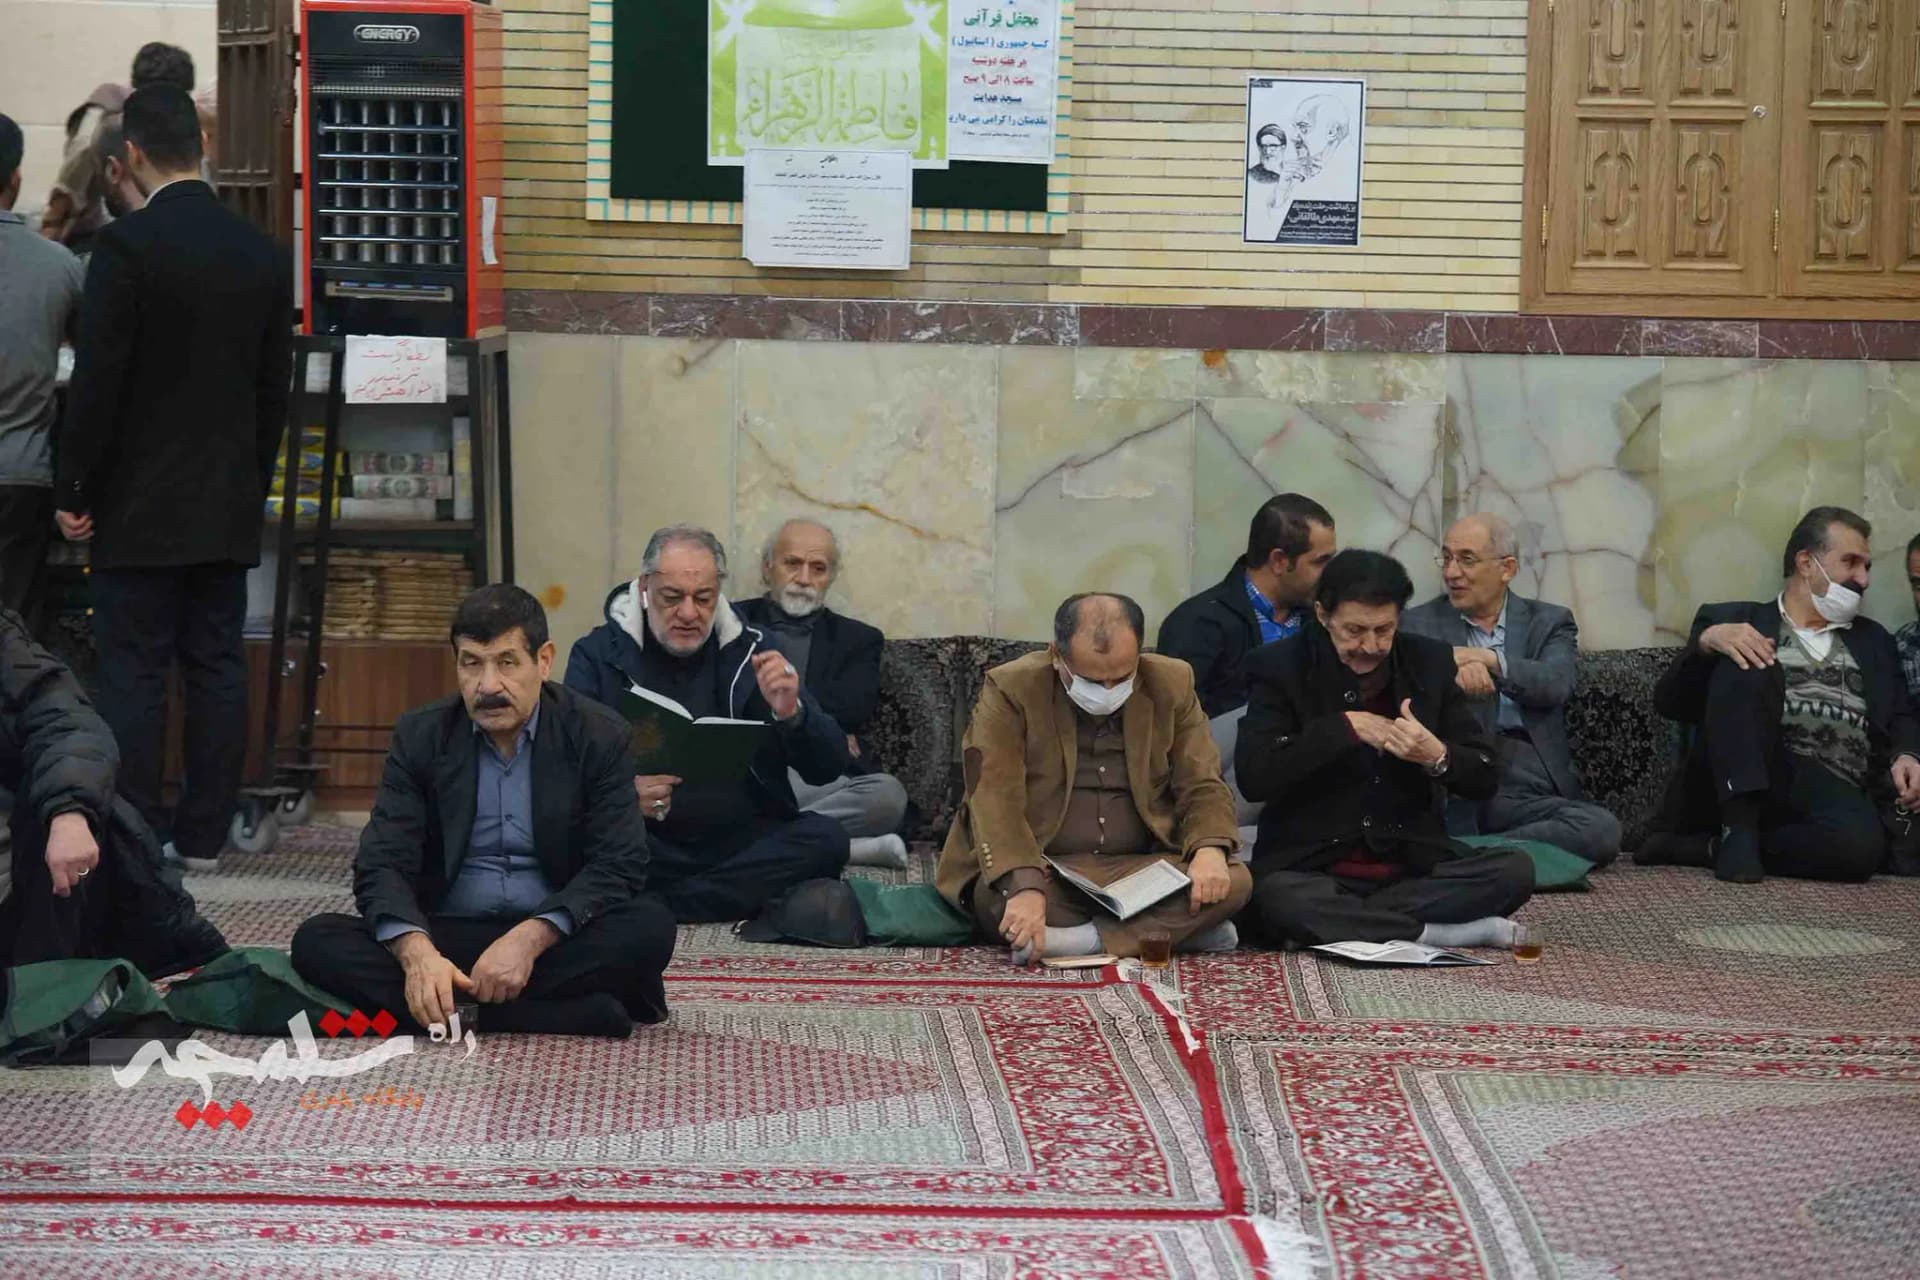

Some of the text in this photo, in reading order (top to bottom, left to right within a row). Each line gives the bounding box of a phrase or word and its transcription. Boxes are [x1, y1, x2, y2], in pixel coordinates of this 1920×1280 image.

[963, 8, 1040, 28] محفل قرآنی
[360, 28, 413, 41] ENERGY
